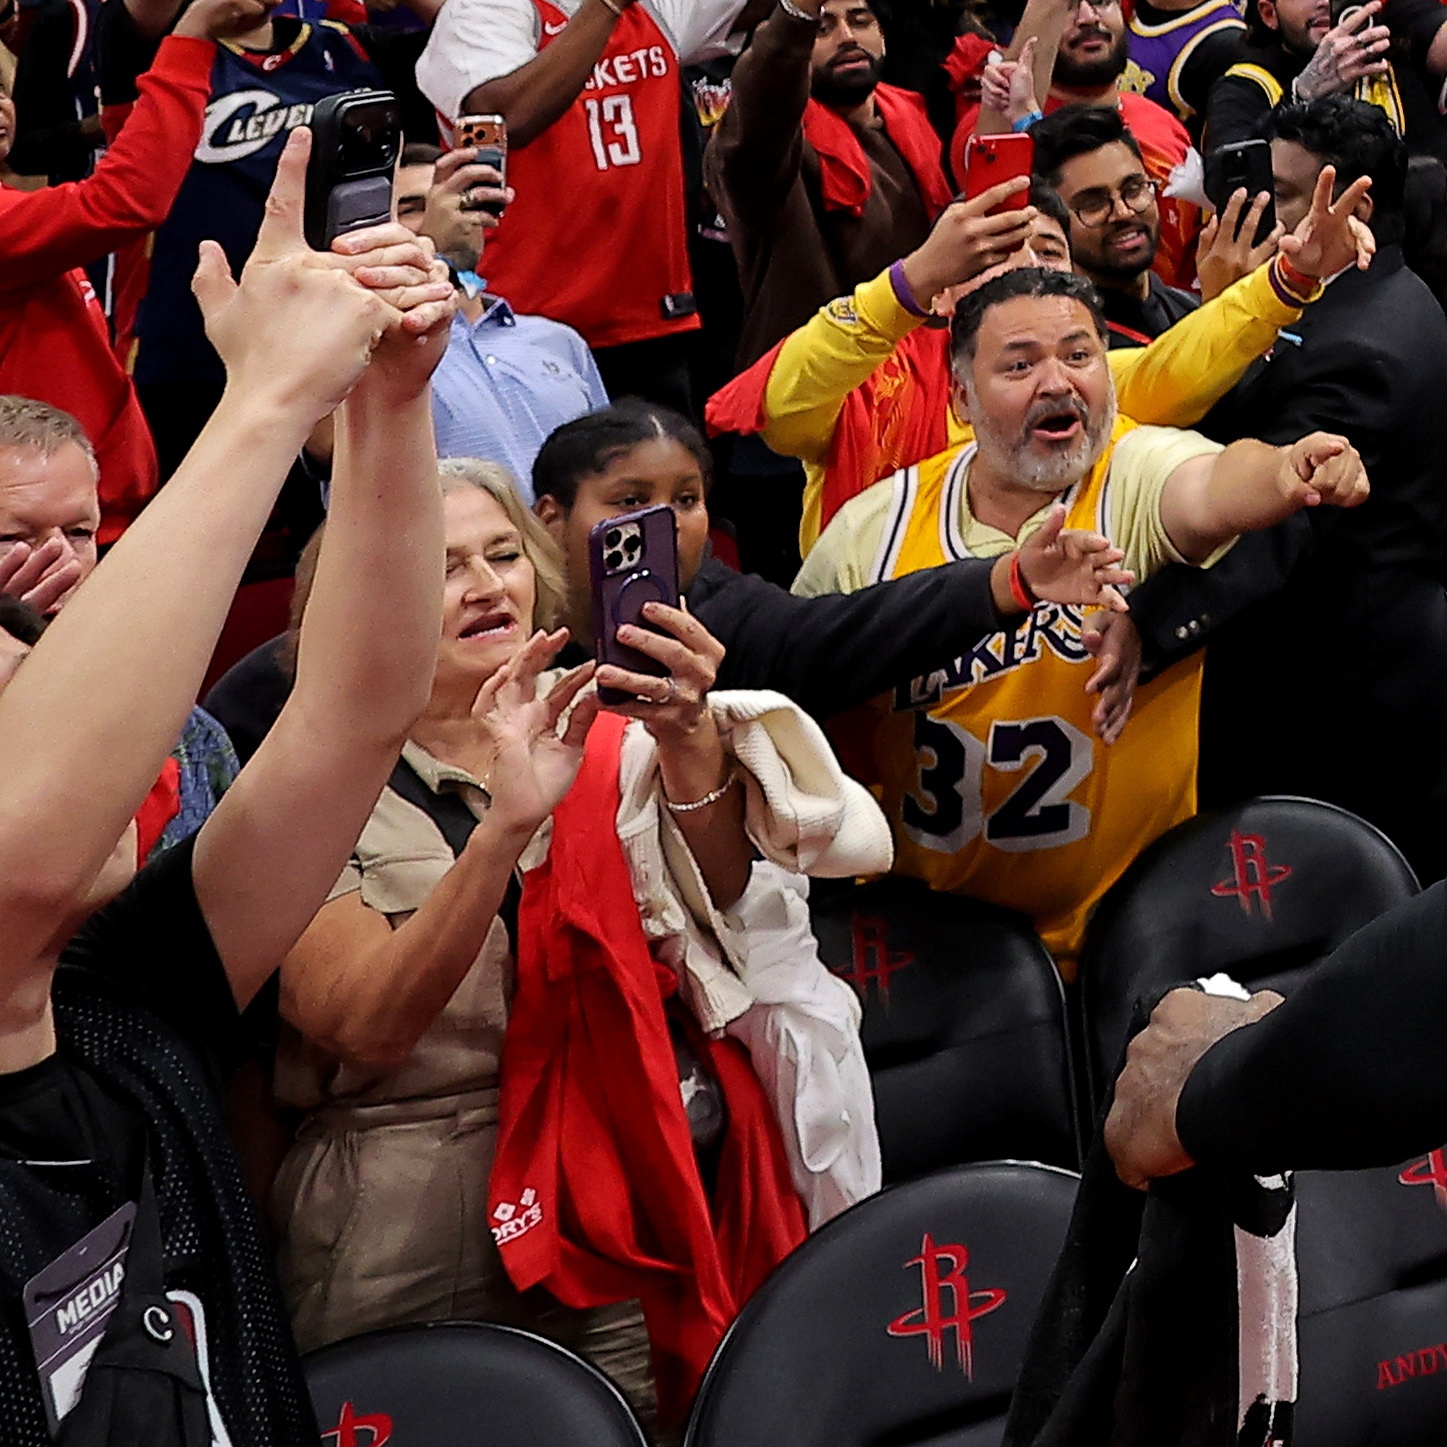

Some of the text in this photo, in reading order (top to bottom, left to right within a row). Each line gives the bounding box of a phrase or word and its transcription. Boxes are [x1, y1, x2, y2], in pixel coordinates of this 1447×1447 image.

[584, 46, 668, 90] KETS
[585, 93, 642, 171] 13
[902, 710, 1094, 853] 32
[56, 1262, 125, 1335] MEDIA
